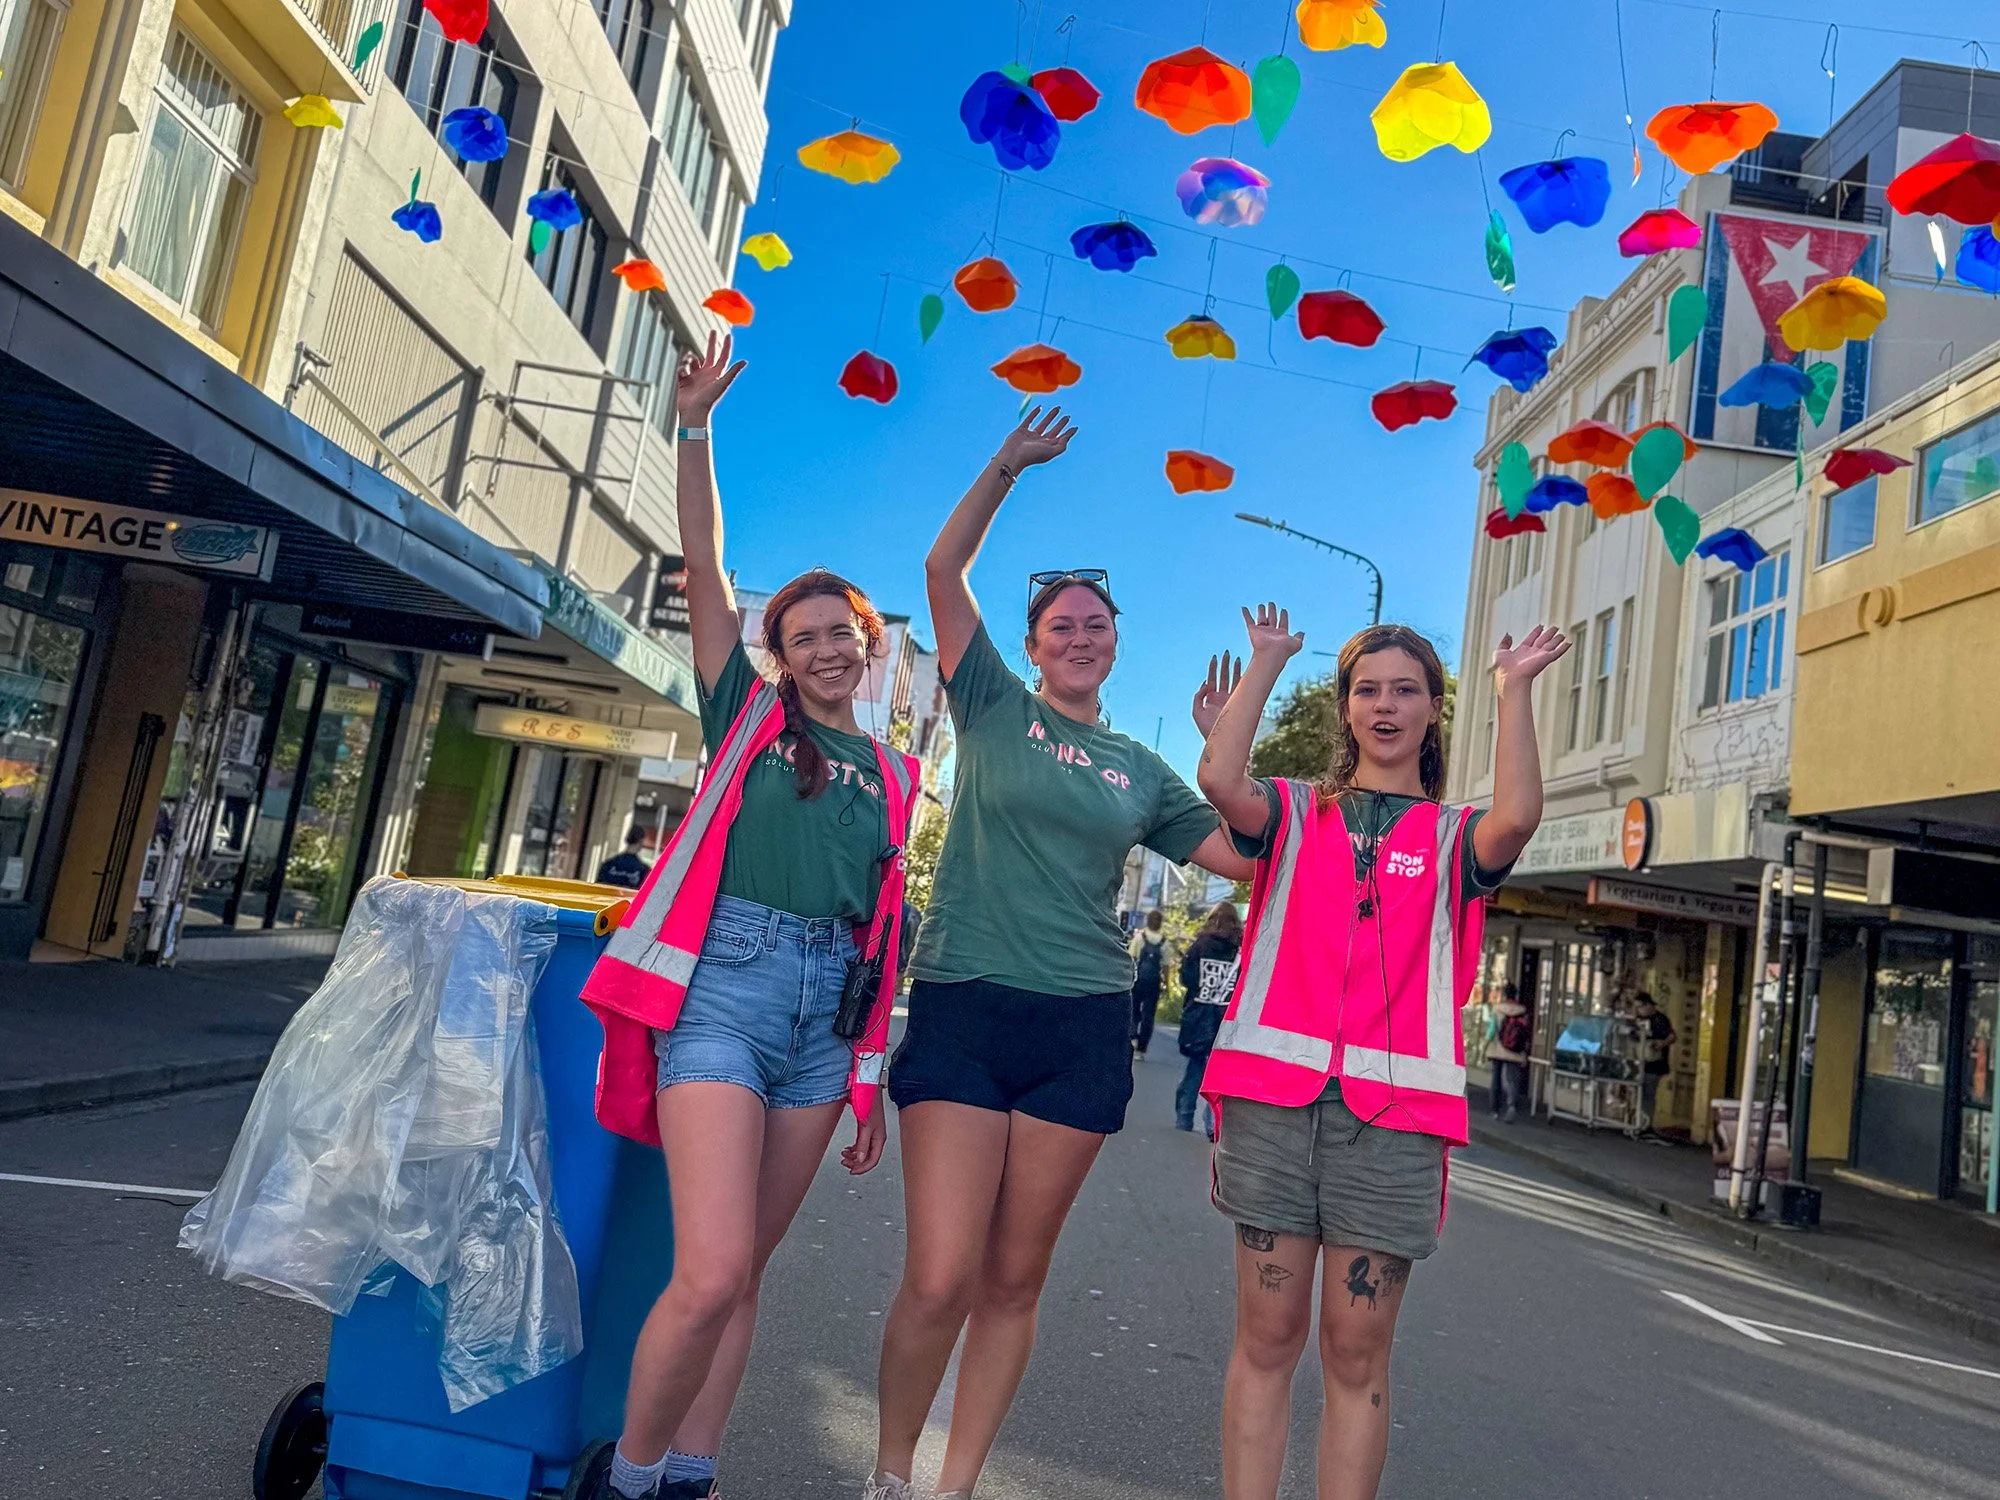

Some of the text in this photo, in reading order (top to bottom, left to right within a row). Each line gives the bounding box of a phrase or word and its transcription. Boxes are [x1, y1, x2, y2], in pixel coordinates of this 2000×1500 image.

[521, 717, 540, 735] R
[566, 724, 583, 740] S
[1390, 851, 1424, 866] NON
[1385, 862, 1426, 878] STOP
[1606, 880, 1676, 905] Vegetarian
